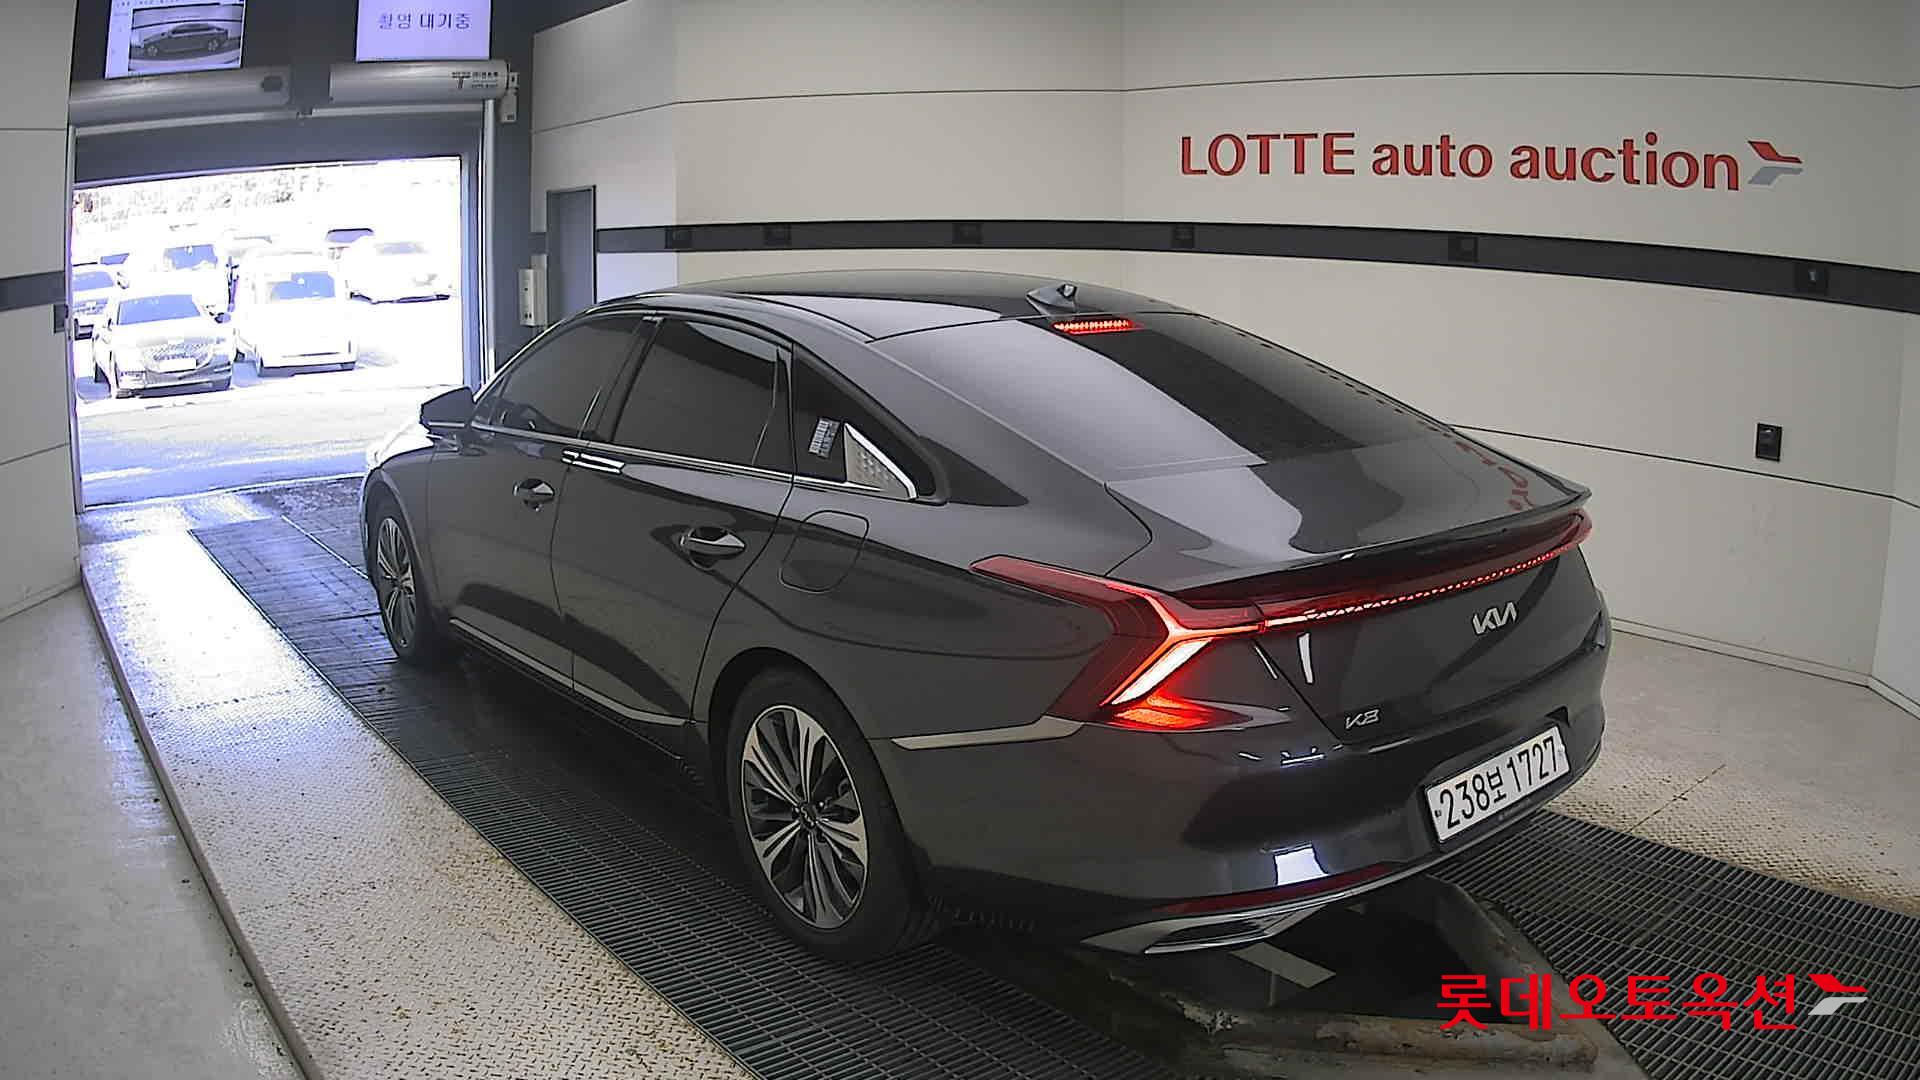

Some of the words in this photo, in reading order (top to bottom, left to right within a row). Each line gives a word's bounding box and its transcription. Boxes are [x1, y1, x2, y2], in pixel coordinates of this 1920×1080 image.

[420, 12, 472, 30] 대기중
[1180, 132, 1356, 176] LOTTE
[1371, 134, 1493, 177] auto
[1509, 131, 1740, 191] auction
[1471, 601, 1518, 634] KIA
[1345, 708, 1381, 730] K8
